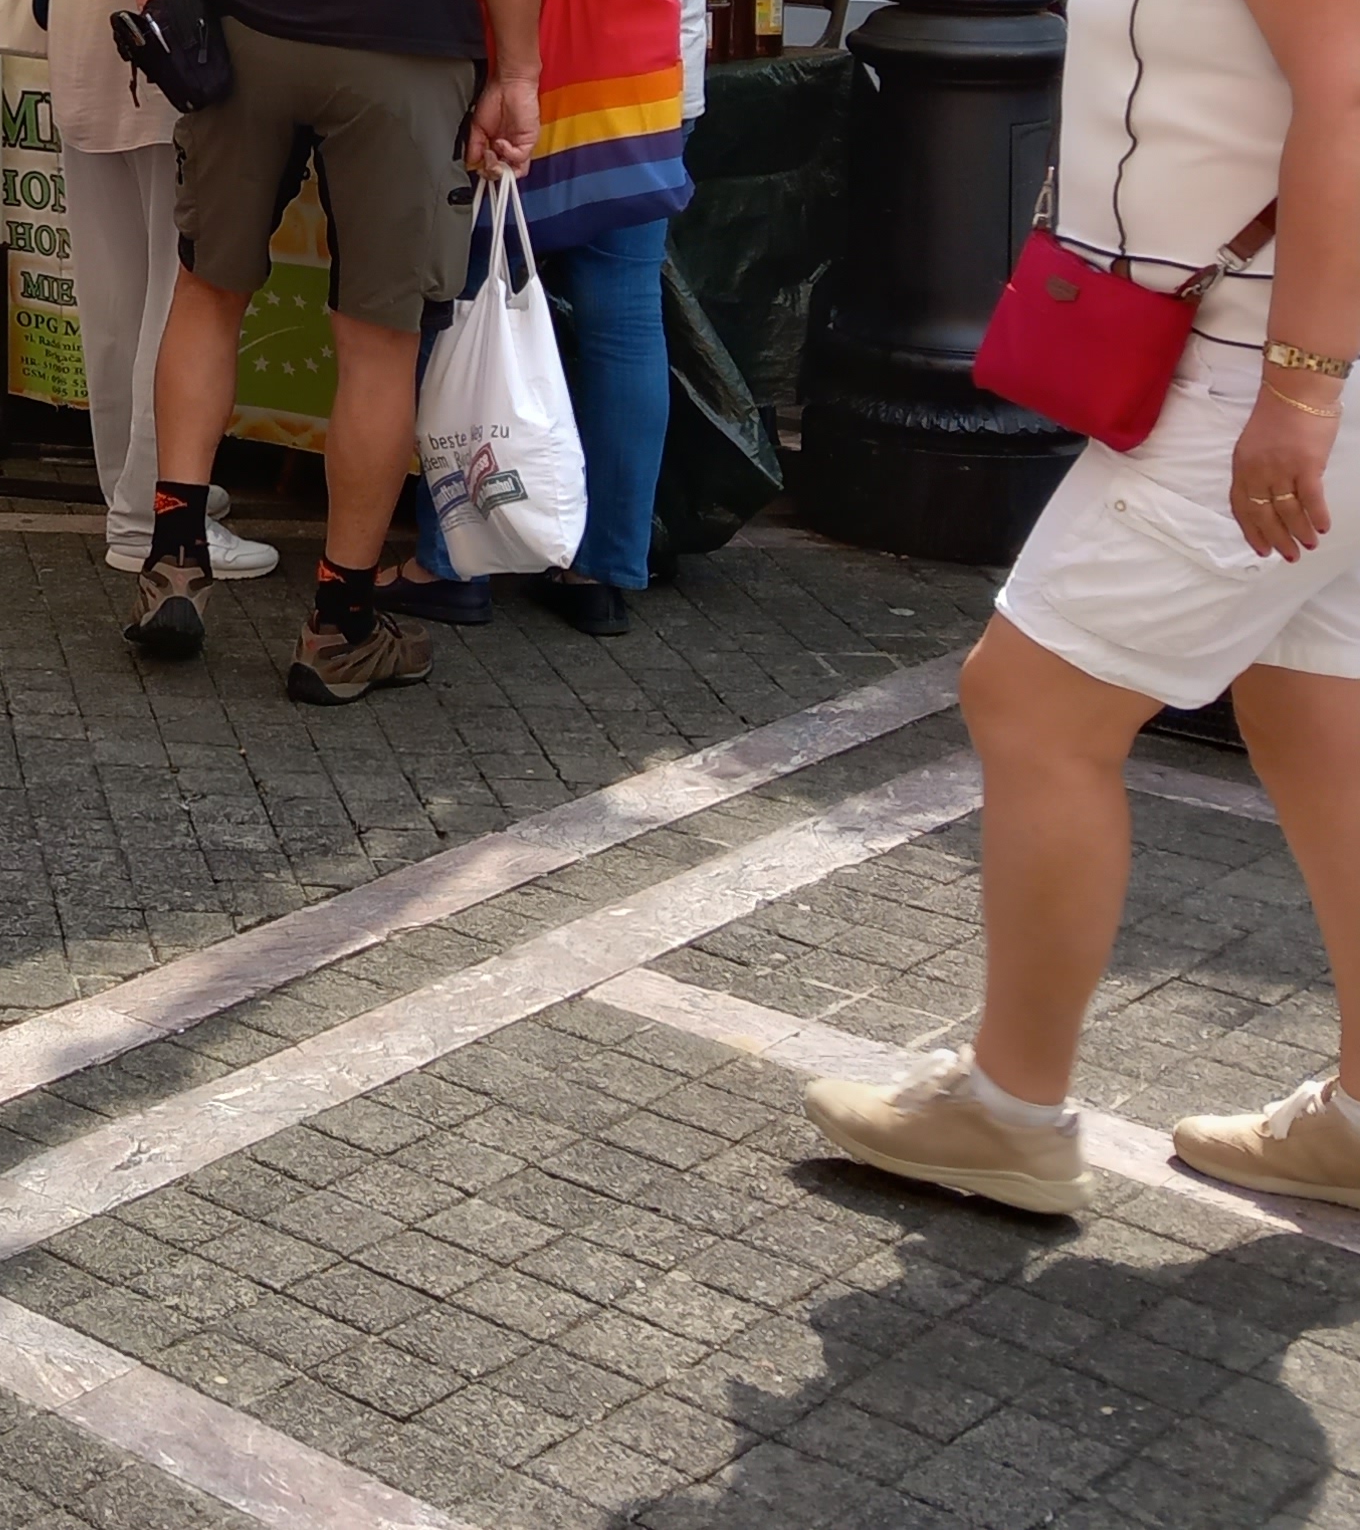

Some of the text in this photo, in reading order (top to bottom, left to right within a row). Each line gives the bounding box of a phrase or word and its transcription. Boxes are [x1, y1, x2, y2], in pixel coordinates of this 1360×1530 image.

[16, 310, 59, 334] OPG
[427, 430, 468, 451] beste
[490, 423, 510, 439] zu
